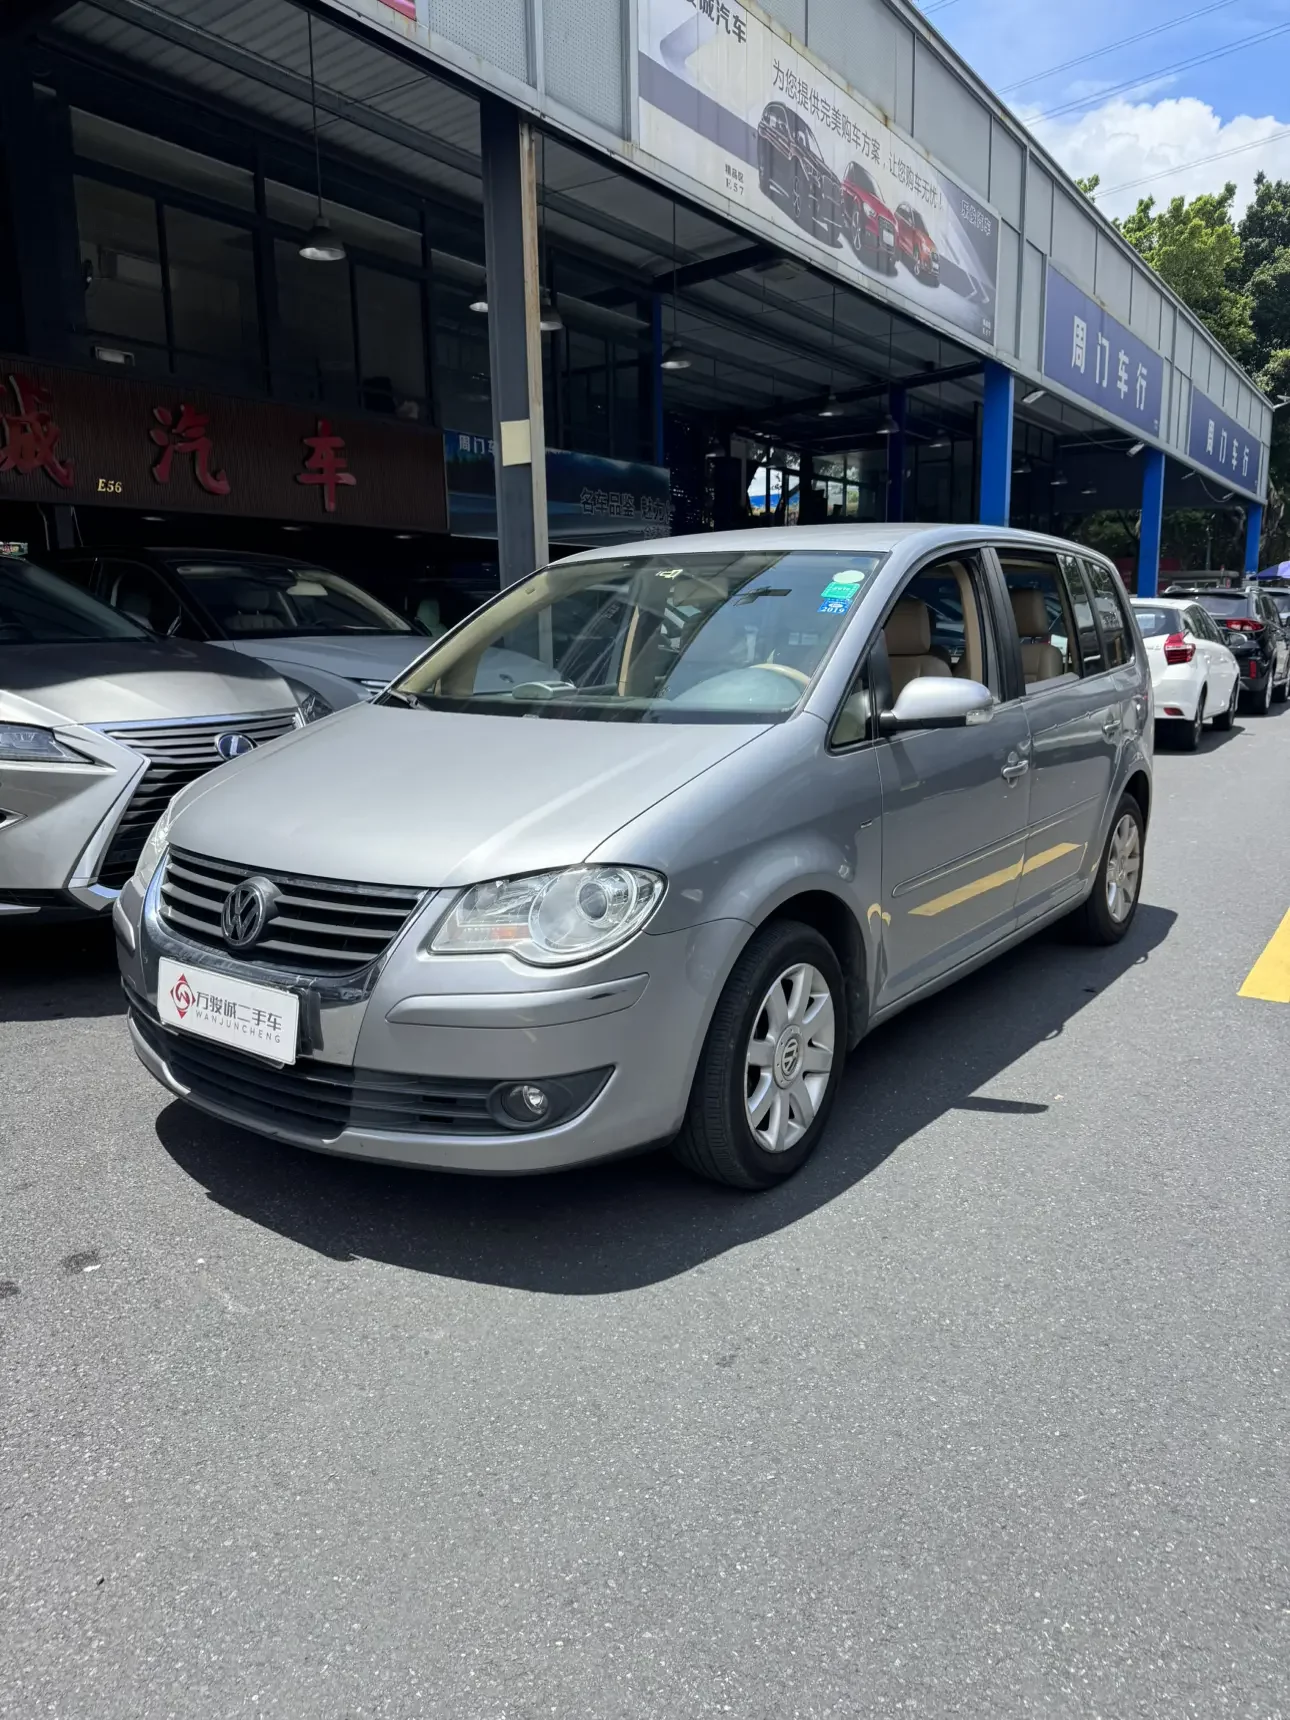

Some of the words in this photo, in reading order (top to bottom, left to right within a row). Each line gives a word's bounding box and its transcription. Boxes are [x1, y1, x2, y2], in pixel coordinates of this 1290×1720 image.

[1071, 315, 1147, 411] 周门车行
[97, 479, 122, 493] E56
[580, 486, 635, 518] 名车品鉴
[196, 991, 282, 1031] 万骏诚二手车
[196, 1010, 281, 1044] WANJUNCHENG
